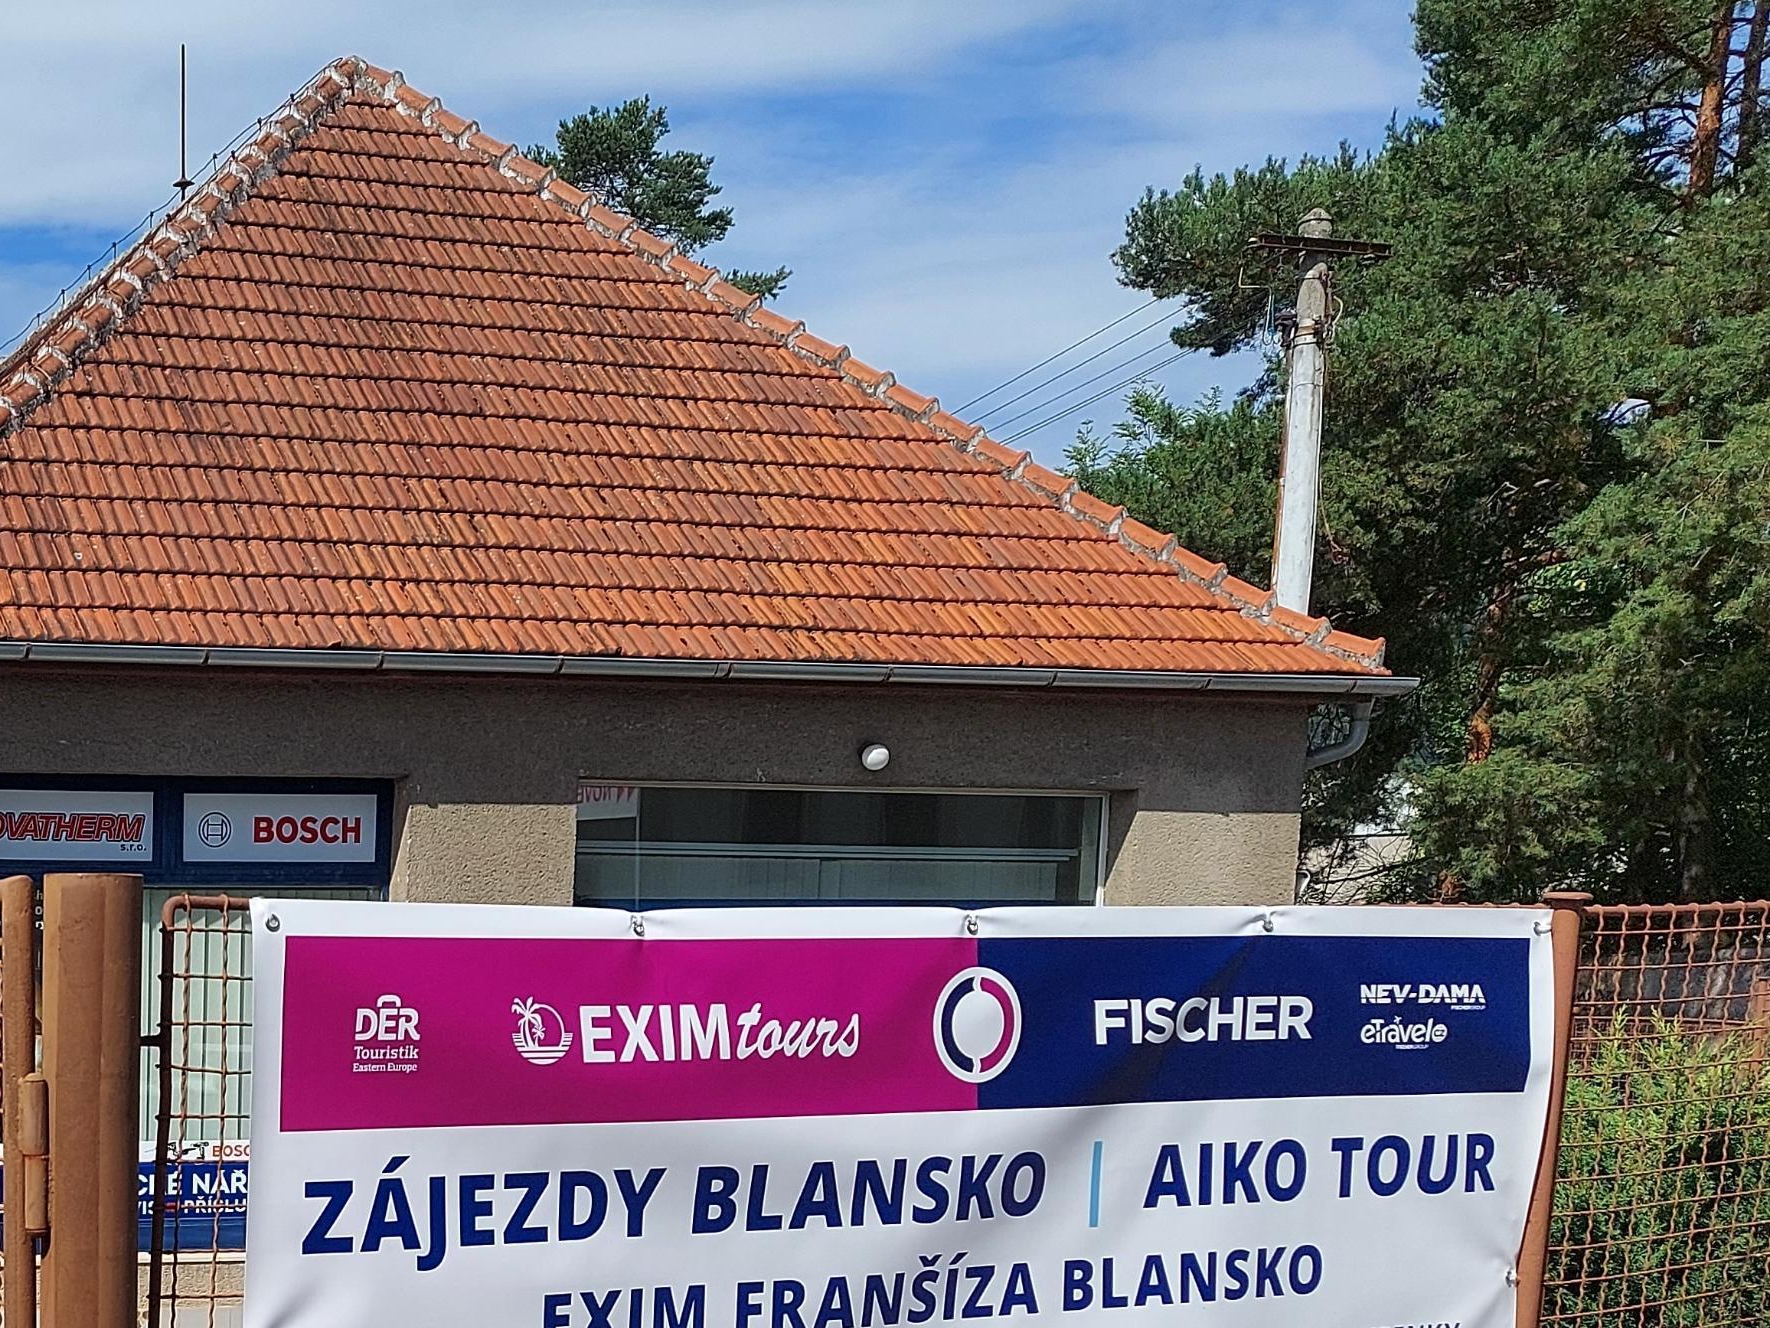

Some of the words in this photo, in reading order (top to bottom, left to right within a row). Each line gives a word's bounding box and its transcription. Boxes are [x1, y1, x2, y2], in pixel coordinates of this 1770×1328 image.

[253, 815, 361, 844] BOSCH
[120, 842, 148, 852] s.r.o.
[1360, 984, 1487, 1004] NEV-DAMA
[354, 1004, 420, 1041] DER
[1094, 995, 1313, 1045] FISCHER
[354, 1045, 419, 1061] Touristik
[353, 1062, 386, 1072] Eastern
[387, 1062, 418, 1074] Europe
[301, 1154, 667, 1272] ZÁJEZDY
[690, 1151, 1047, 1235] BLANSKO
[1142, 1137, 1307, 1209] AIKO
[1331, 1132, 1496, 1199] TOUR
[1062, 1244, 1324, 1312] BLANSKO
